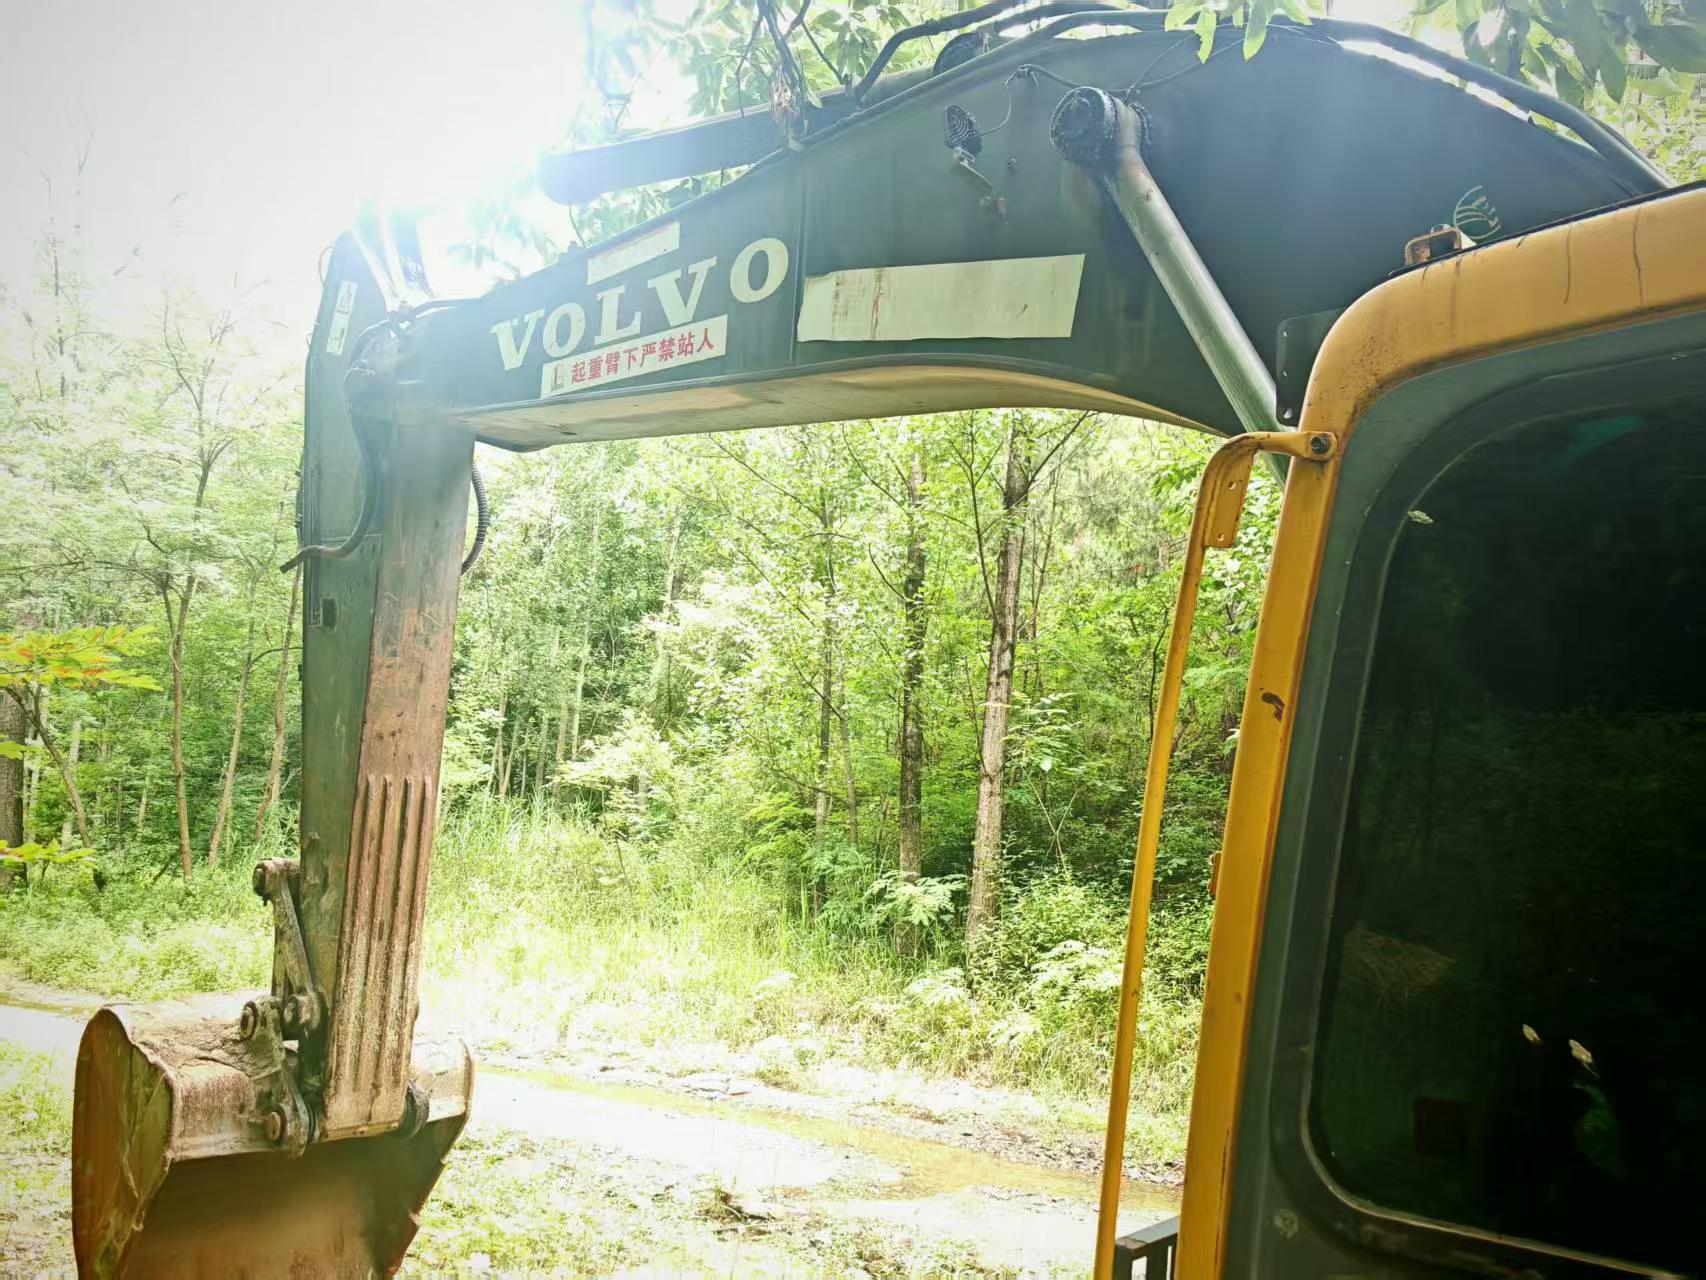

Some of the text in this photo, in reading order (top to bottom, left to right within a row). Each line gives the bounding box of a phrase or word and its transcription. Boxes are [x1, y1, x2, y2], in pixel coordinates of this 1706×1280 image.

[491, 237, 789, 371] VOLVO
[571, 327, 714, 385] 起重臂下严禁站人
